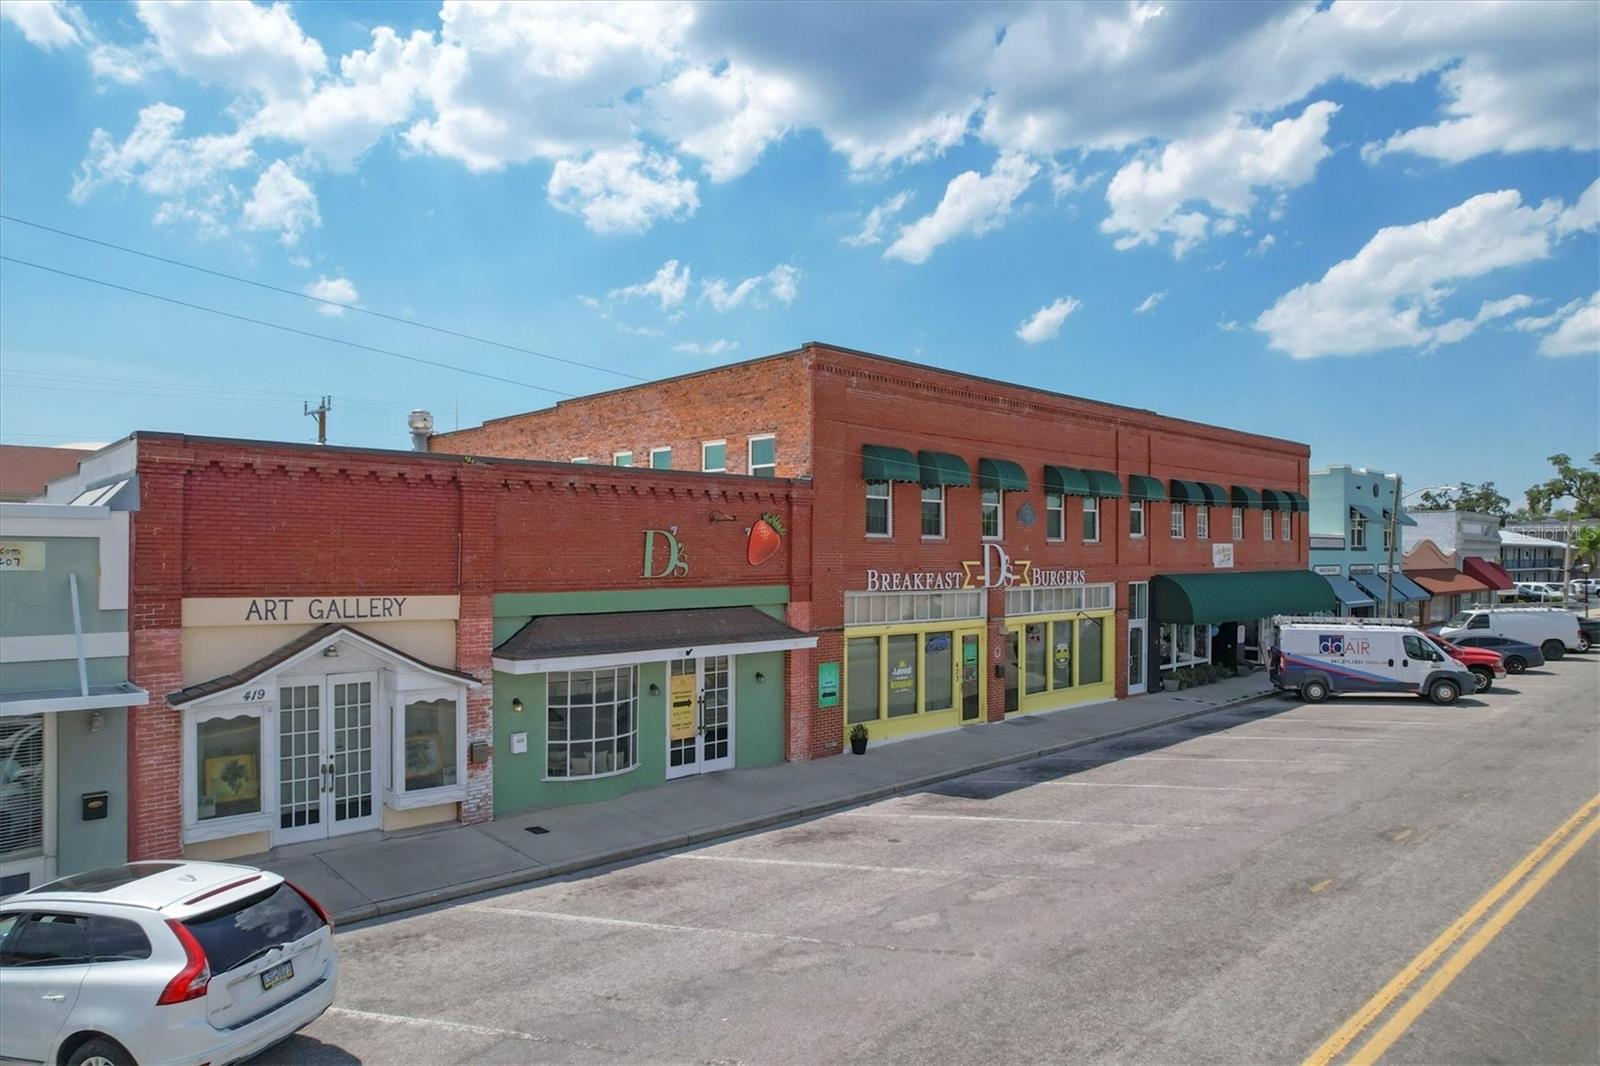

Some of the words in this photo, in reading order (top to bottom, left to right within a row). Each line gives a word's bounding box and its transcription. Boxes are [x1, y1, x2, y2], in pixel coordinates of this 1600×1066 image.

[866, 569, 963, 592] BREAKFAST
[1032, 568, 1086, 587] BURGERS
[245, 599, 294, 621] ART
[308, 597, 407, 620] GALLERY
[242, 689, 265, 701] 419
